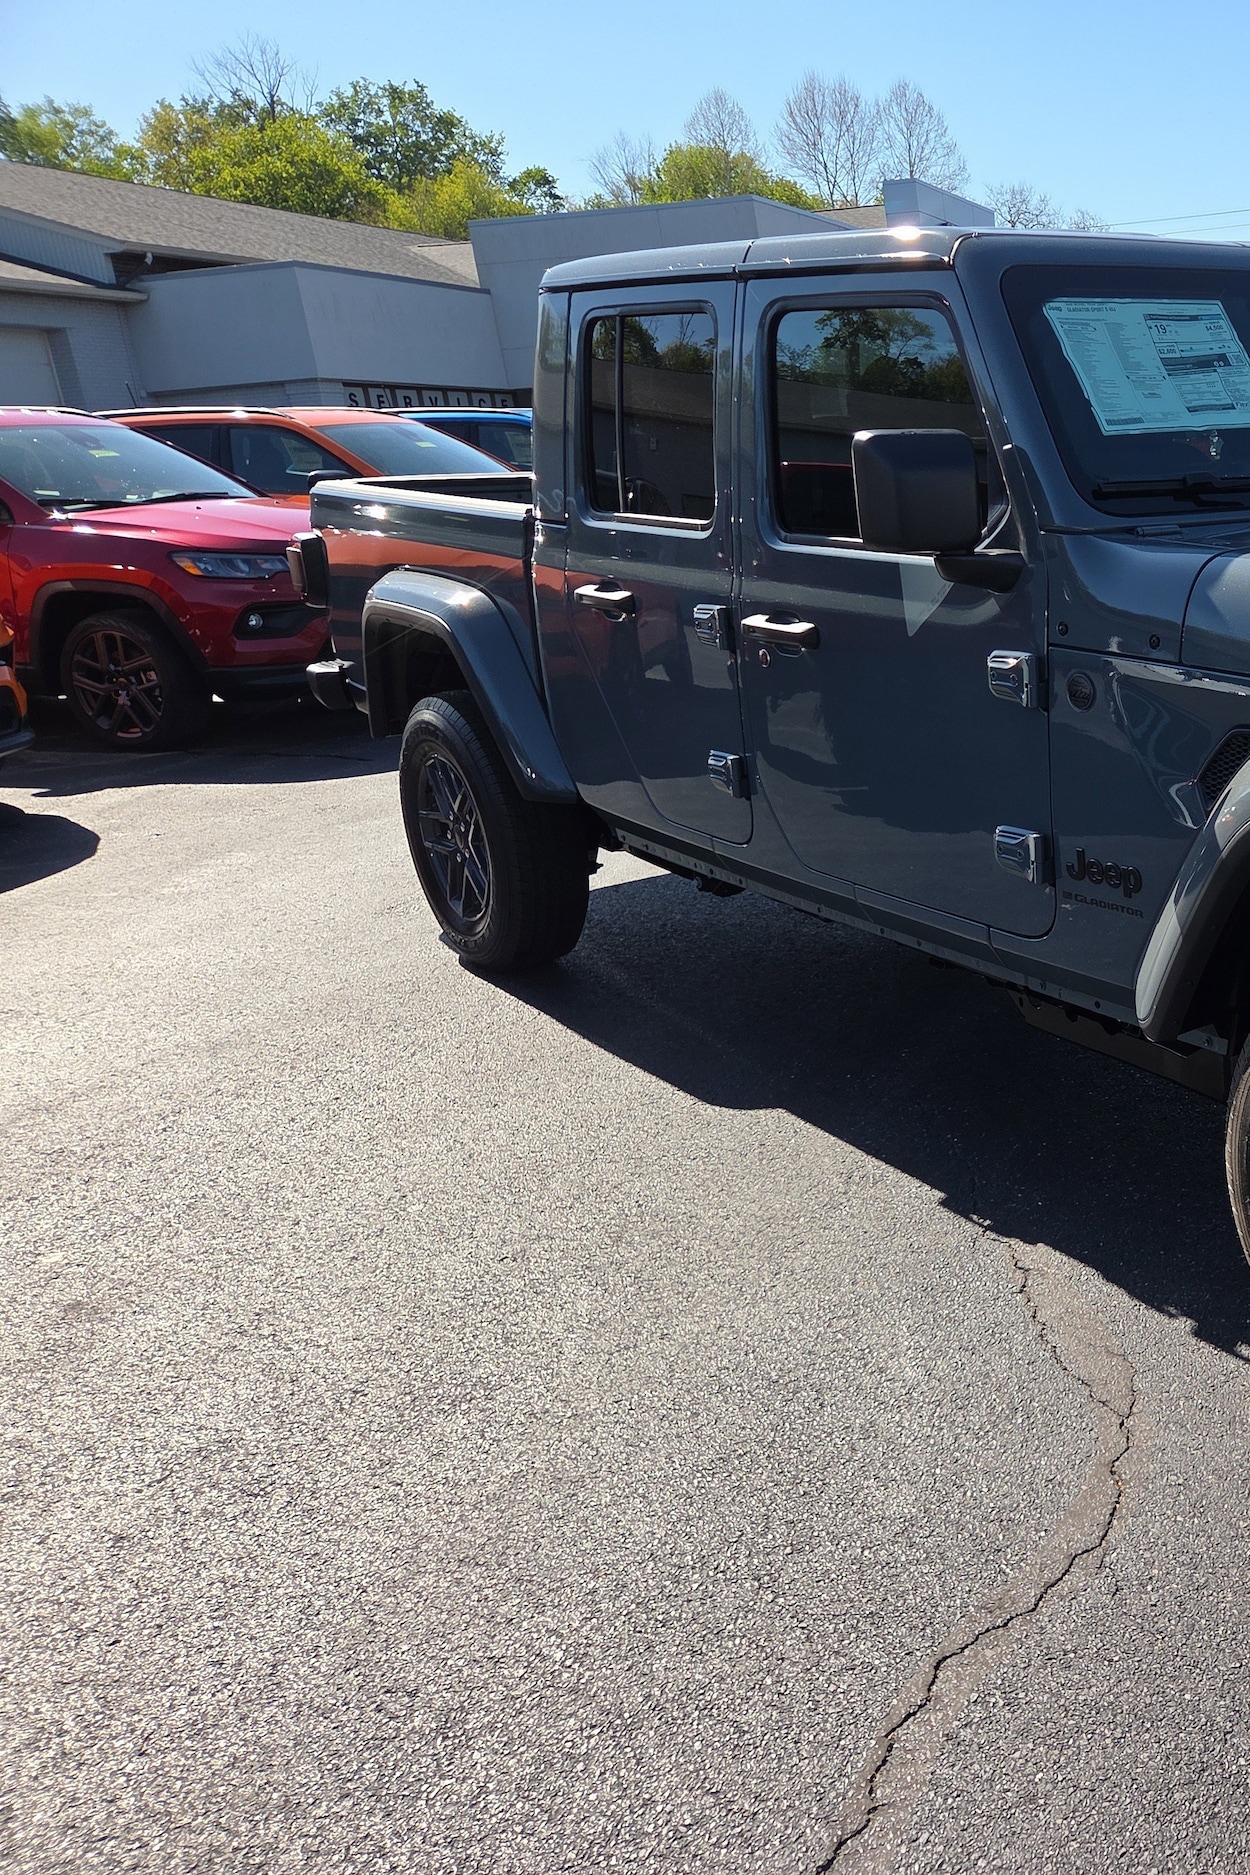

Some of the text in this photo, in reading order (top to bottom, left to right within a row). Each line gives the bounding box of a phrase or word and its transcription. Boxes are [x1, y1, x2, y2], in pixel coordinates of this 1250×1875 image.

[1154, 323, 1167, 334] 19
[1065, 846, 1143, 899] Jeep
[1074, 893, 1144, 918] GLADIATOR
